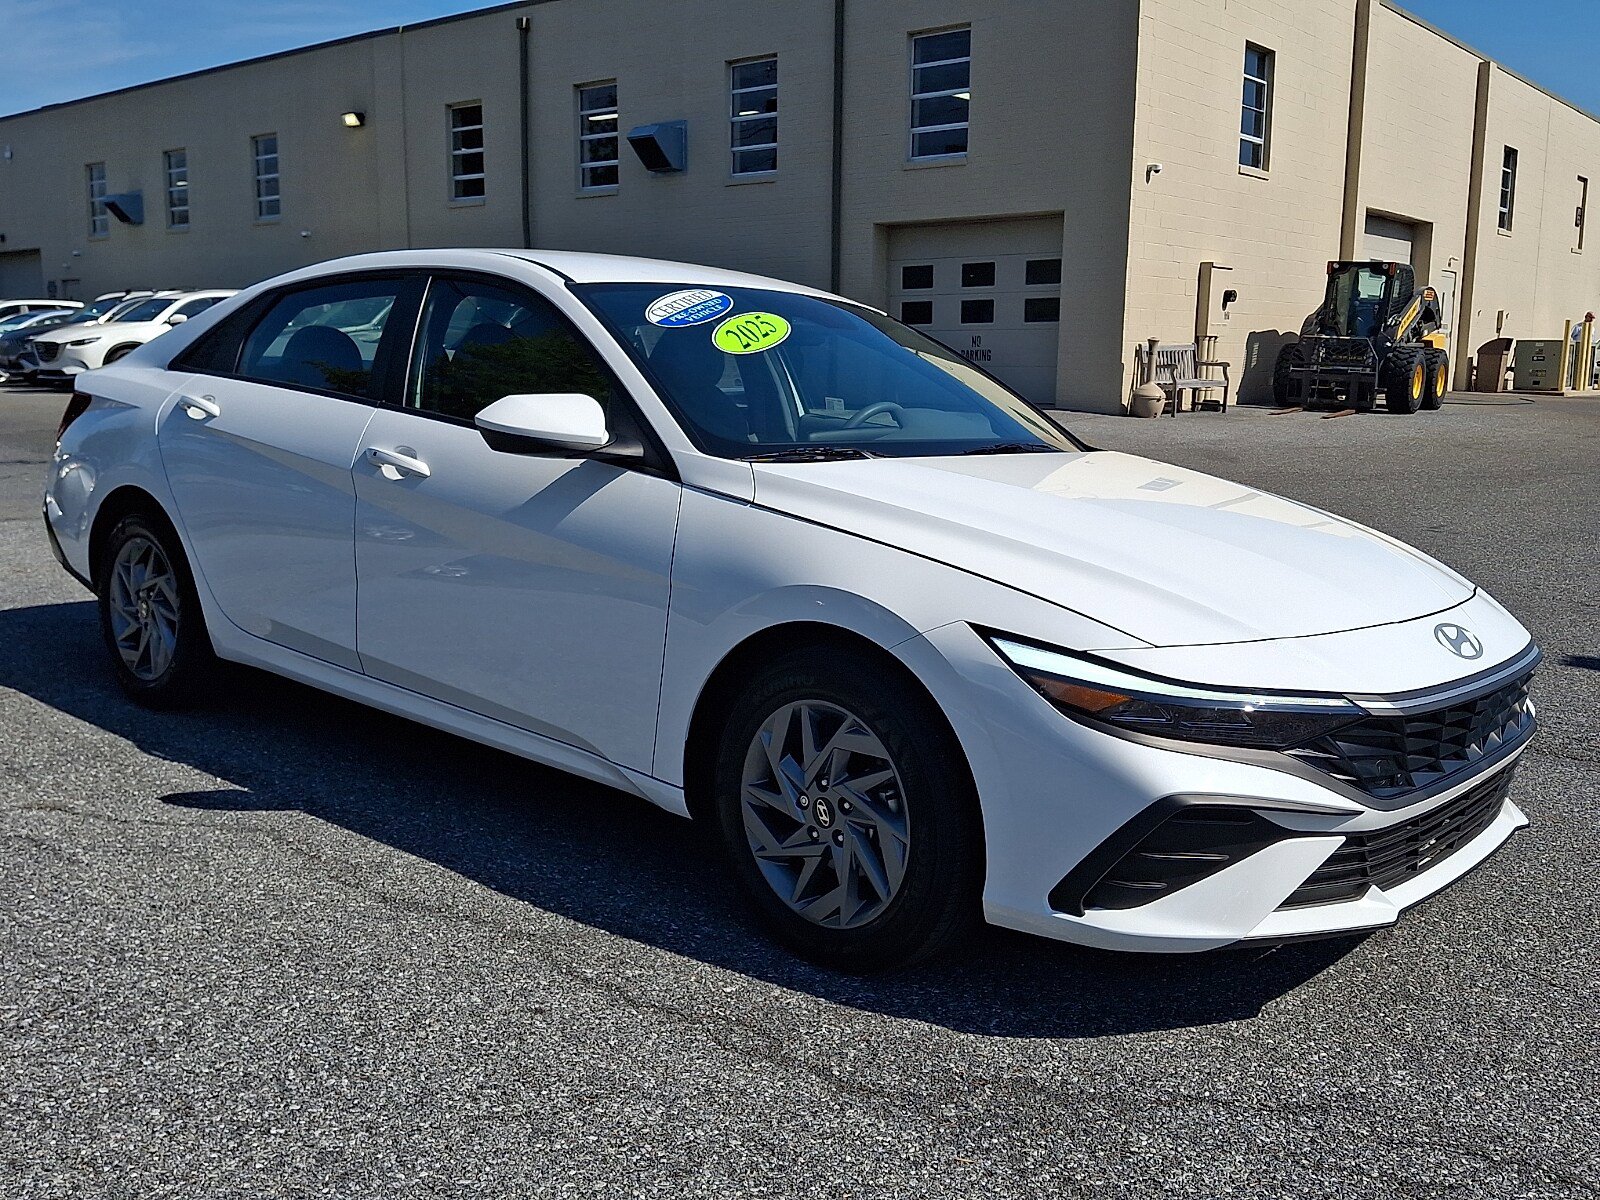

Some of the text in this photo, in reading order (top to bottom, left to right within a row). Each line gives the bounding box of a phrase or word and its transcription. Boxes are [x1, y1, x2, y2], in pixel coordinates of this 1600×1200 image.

[651, 290, 714, 318] CERTIFIED
[668, 298, 723, 323] PRE-OWNED
[684, 304, 725, 322] VEHICLE
[725, 314, 777, 350] 2025
[971, 335, 982, 348] NO
